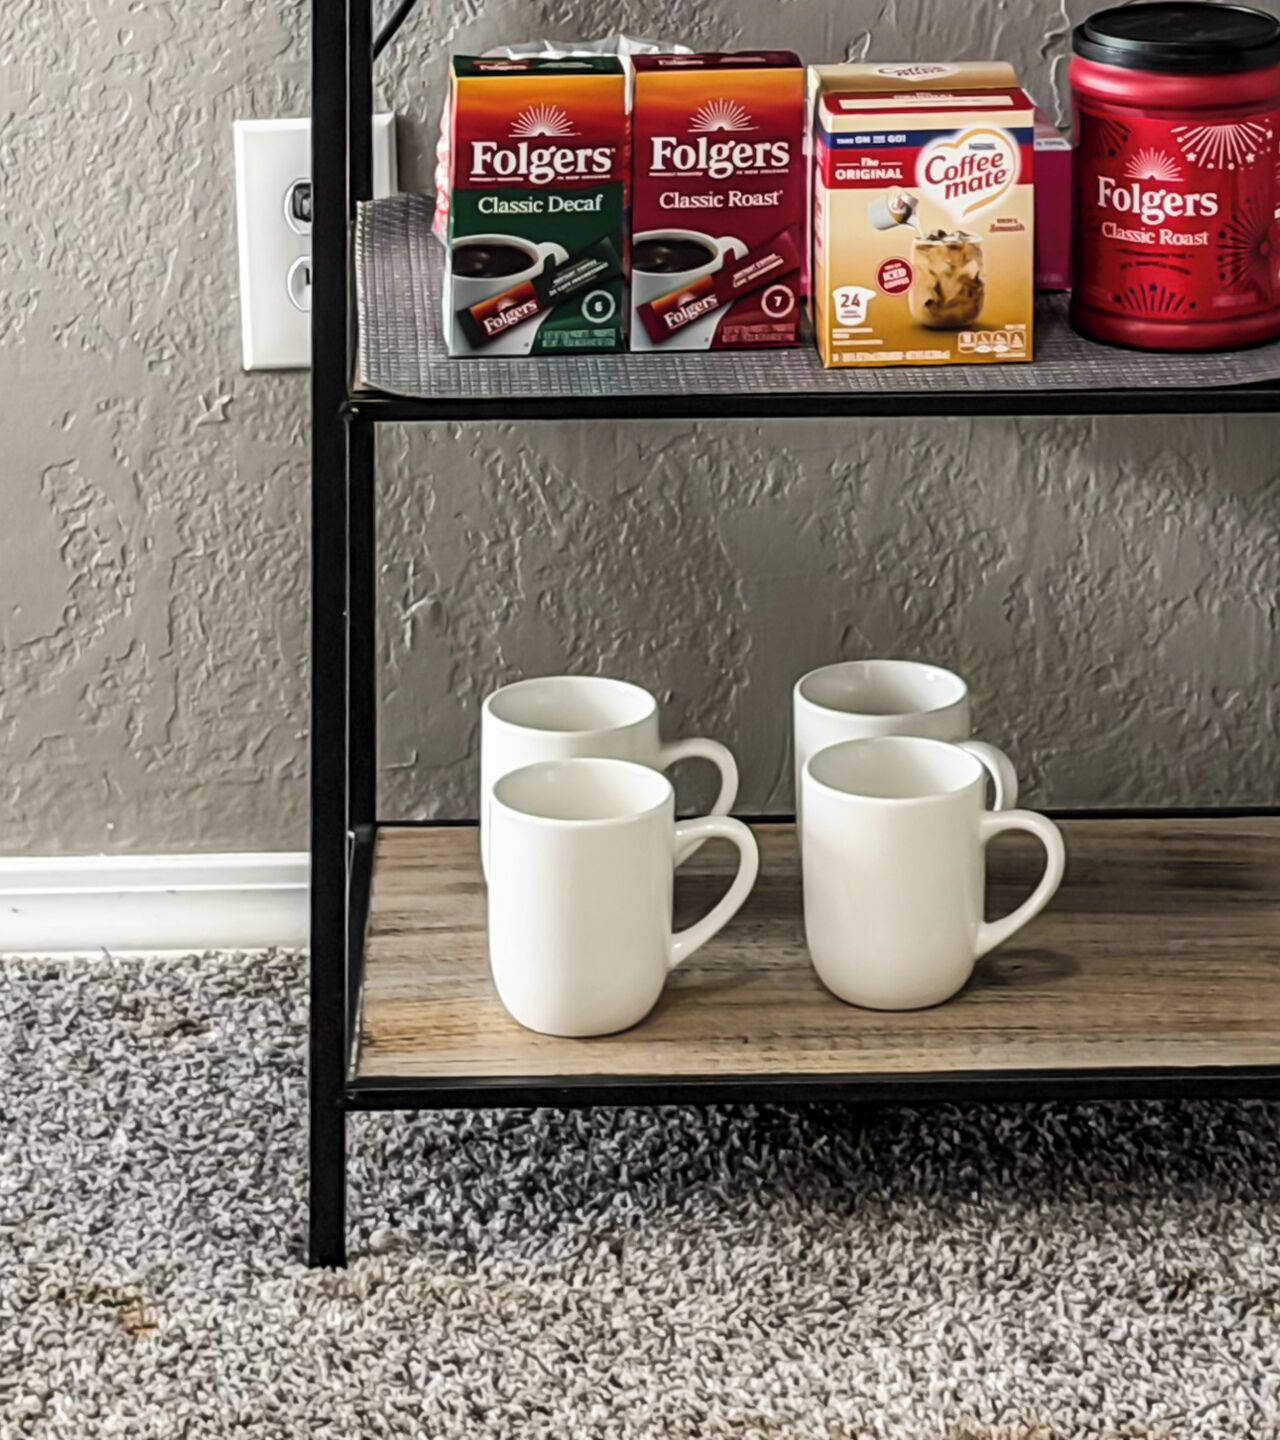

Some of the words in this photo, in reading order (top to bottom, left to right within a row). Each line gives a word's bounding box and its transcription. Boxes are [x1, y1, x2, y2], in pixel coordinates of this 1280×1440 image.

[854, 135, 871, 144] ON
[469, 141, 613, 185] Folgers
[649, 136, 791, 180] Folgers
[860, 157, 880, 167] The
[925, 152, 1004, 185] Coffee
[834, 167, 904, 181] ORIGINAL
[944, 168, 1007, 200] mate
[478, 196, 544, 215] Classic
[547, 194, 604, 213] Decaf
[658, 191, 724, 210] Classic
[727, 190, 780, 208] Roast
[1097, 175, 1219, 226] Folgers
[1101, 221, 1156, 245] Classic
[1159, 228, 1210, 246] Roast
[663, 294, 718, 328] Folgers
[773, 296, 783, 308] 7
[840, 293, 861, 308] 24
[482, 299, 538, 334] Folgers
